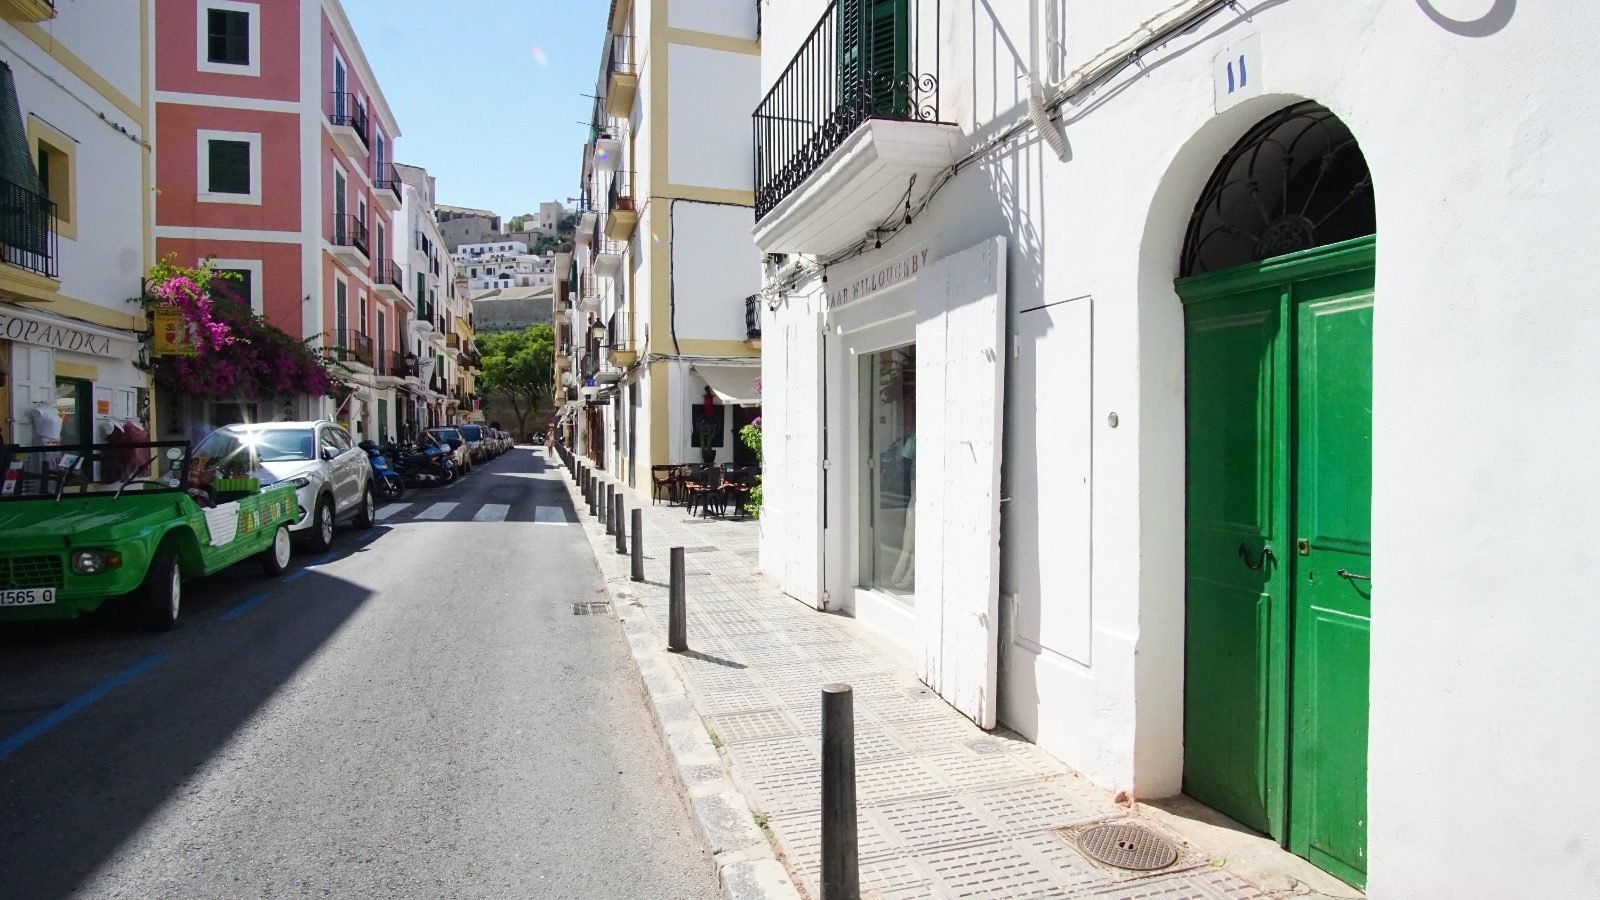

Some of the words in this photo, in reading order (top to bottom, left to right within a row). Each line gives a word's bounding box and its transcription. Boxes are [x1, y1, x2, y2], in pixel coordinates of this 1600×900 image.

[1226, 54, 1247, 94] 11
[852, 249, 928, 300] WILLOUGHBY
[0, 590, 36, 605] 1565
